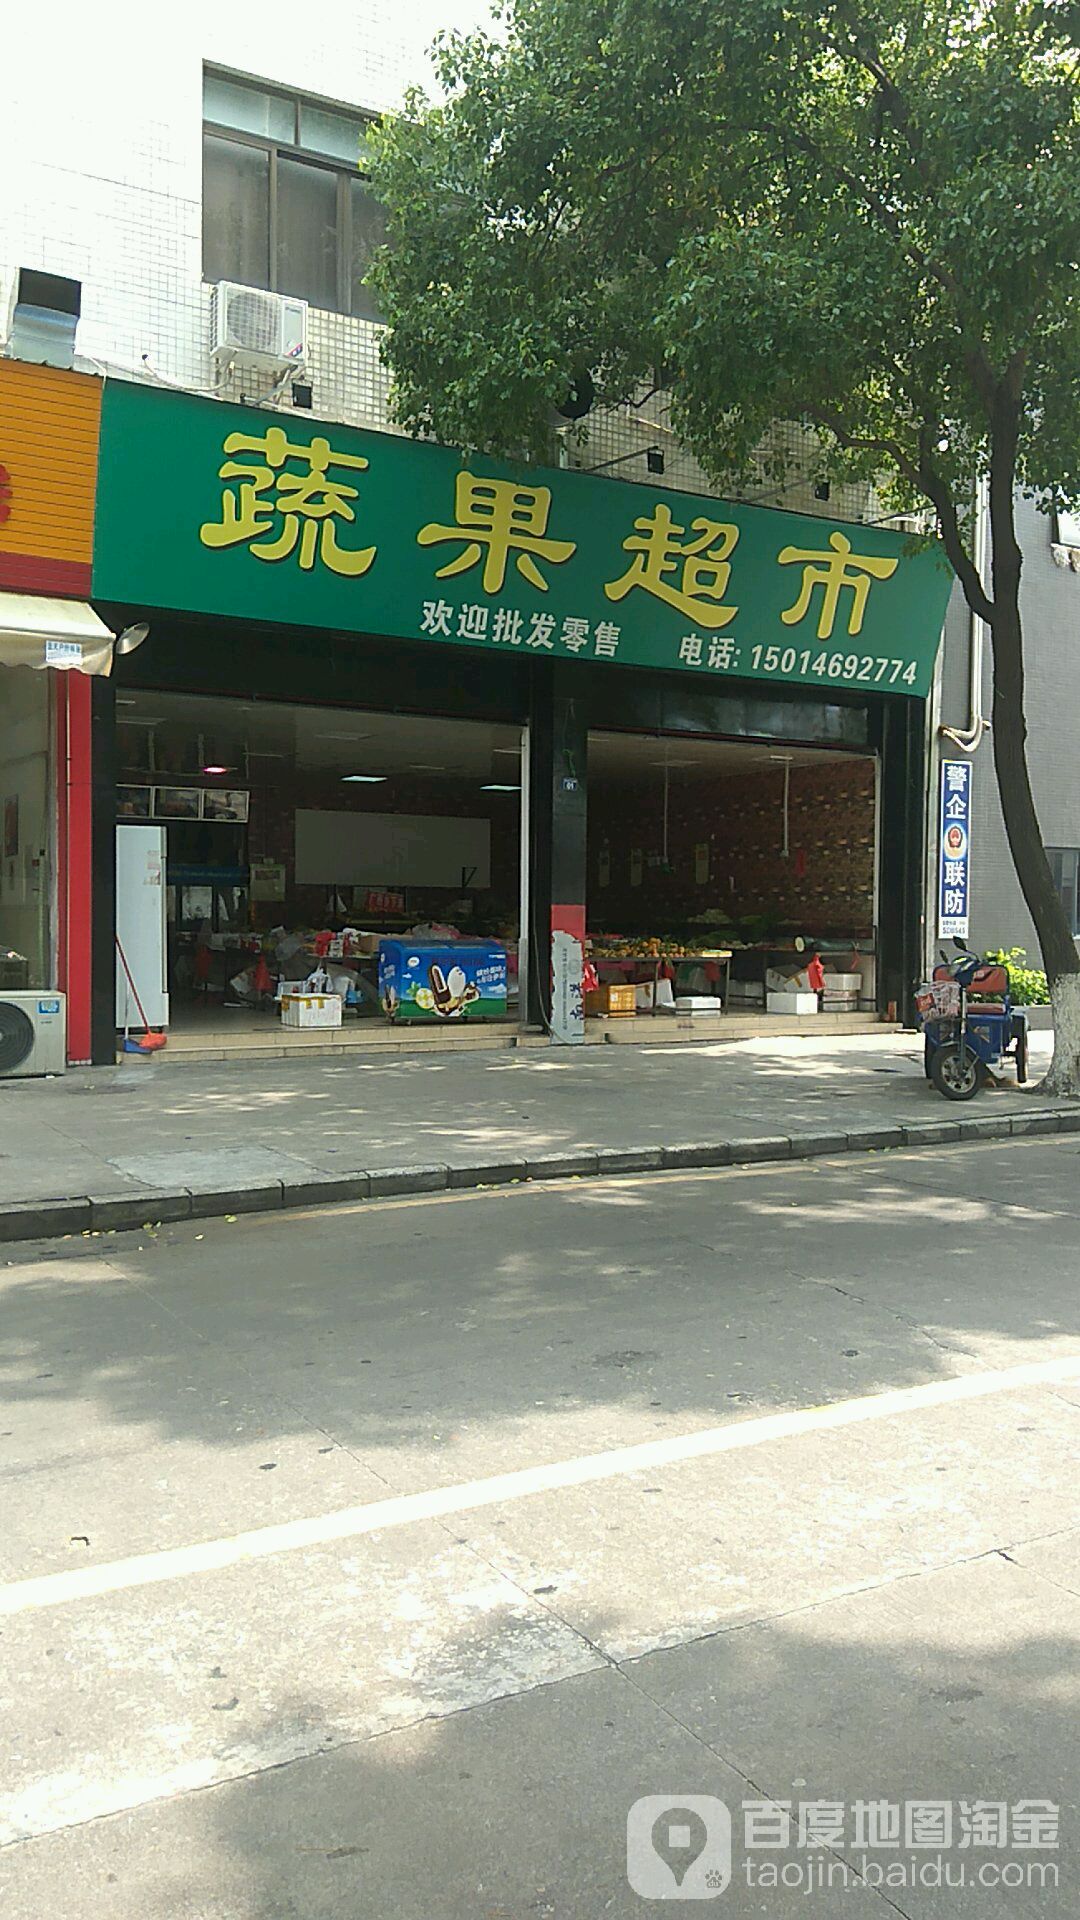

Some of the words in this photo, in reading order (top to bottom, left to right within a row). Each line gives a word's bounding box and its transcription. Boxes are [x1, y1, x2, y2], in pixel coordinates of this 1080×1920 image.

[200, 427, 898, 640] 蔬果超市
[419, 600, 621, 657] 欢迎批发零售
